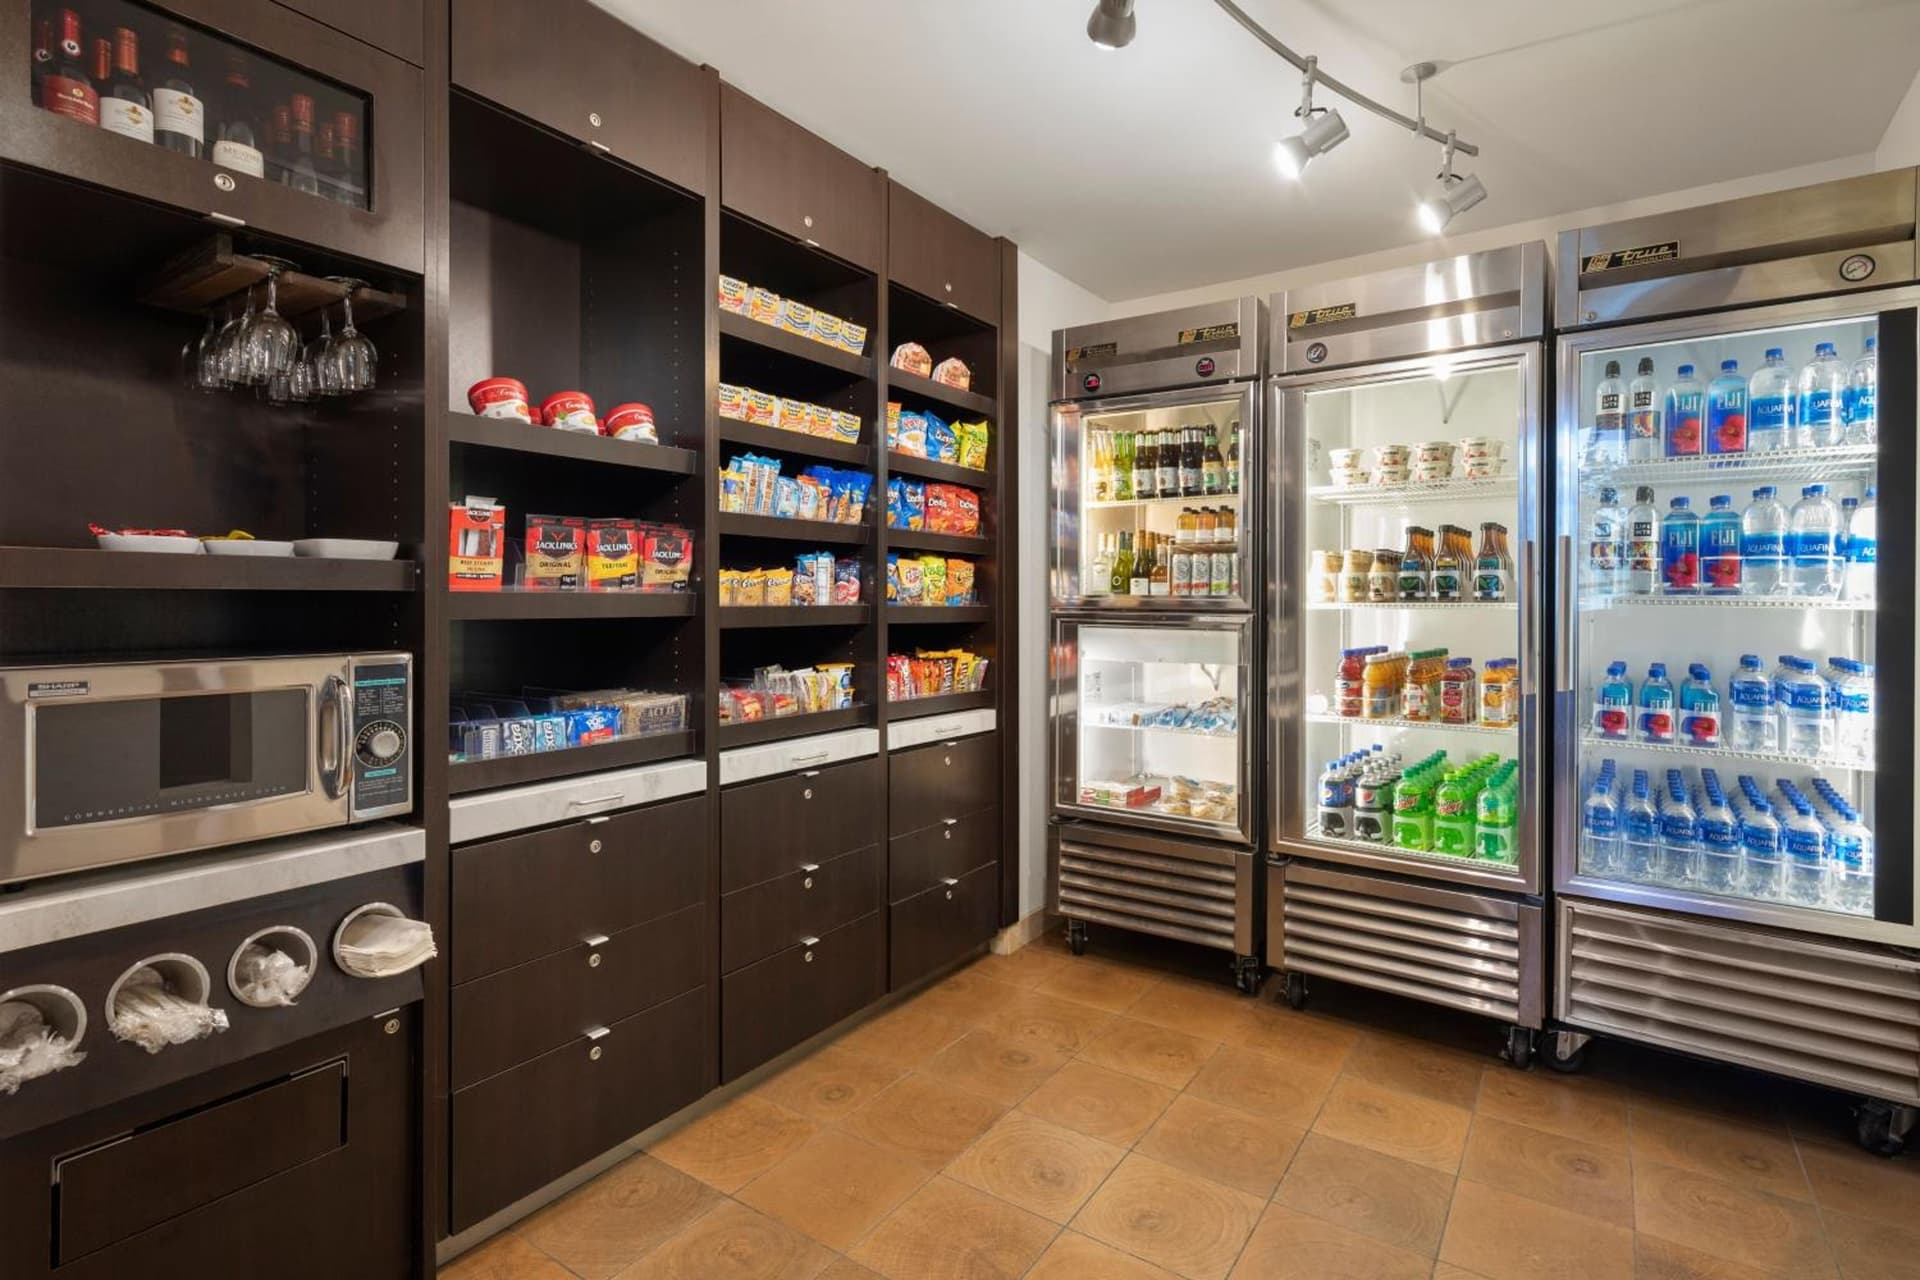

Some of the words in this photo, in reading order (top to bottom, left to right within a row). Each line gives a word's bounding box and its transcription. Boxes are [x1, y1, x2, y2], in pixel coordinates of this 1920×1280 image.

[1669, 530, 1693, 547] FIJI
[1711, 529, 1736, 546] FIJI
[539, 561, 572, 569] ORIGINAL
